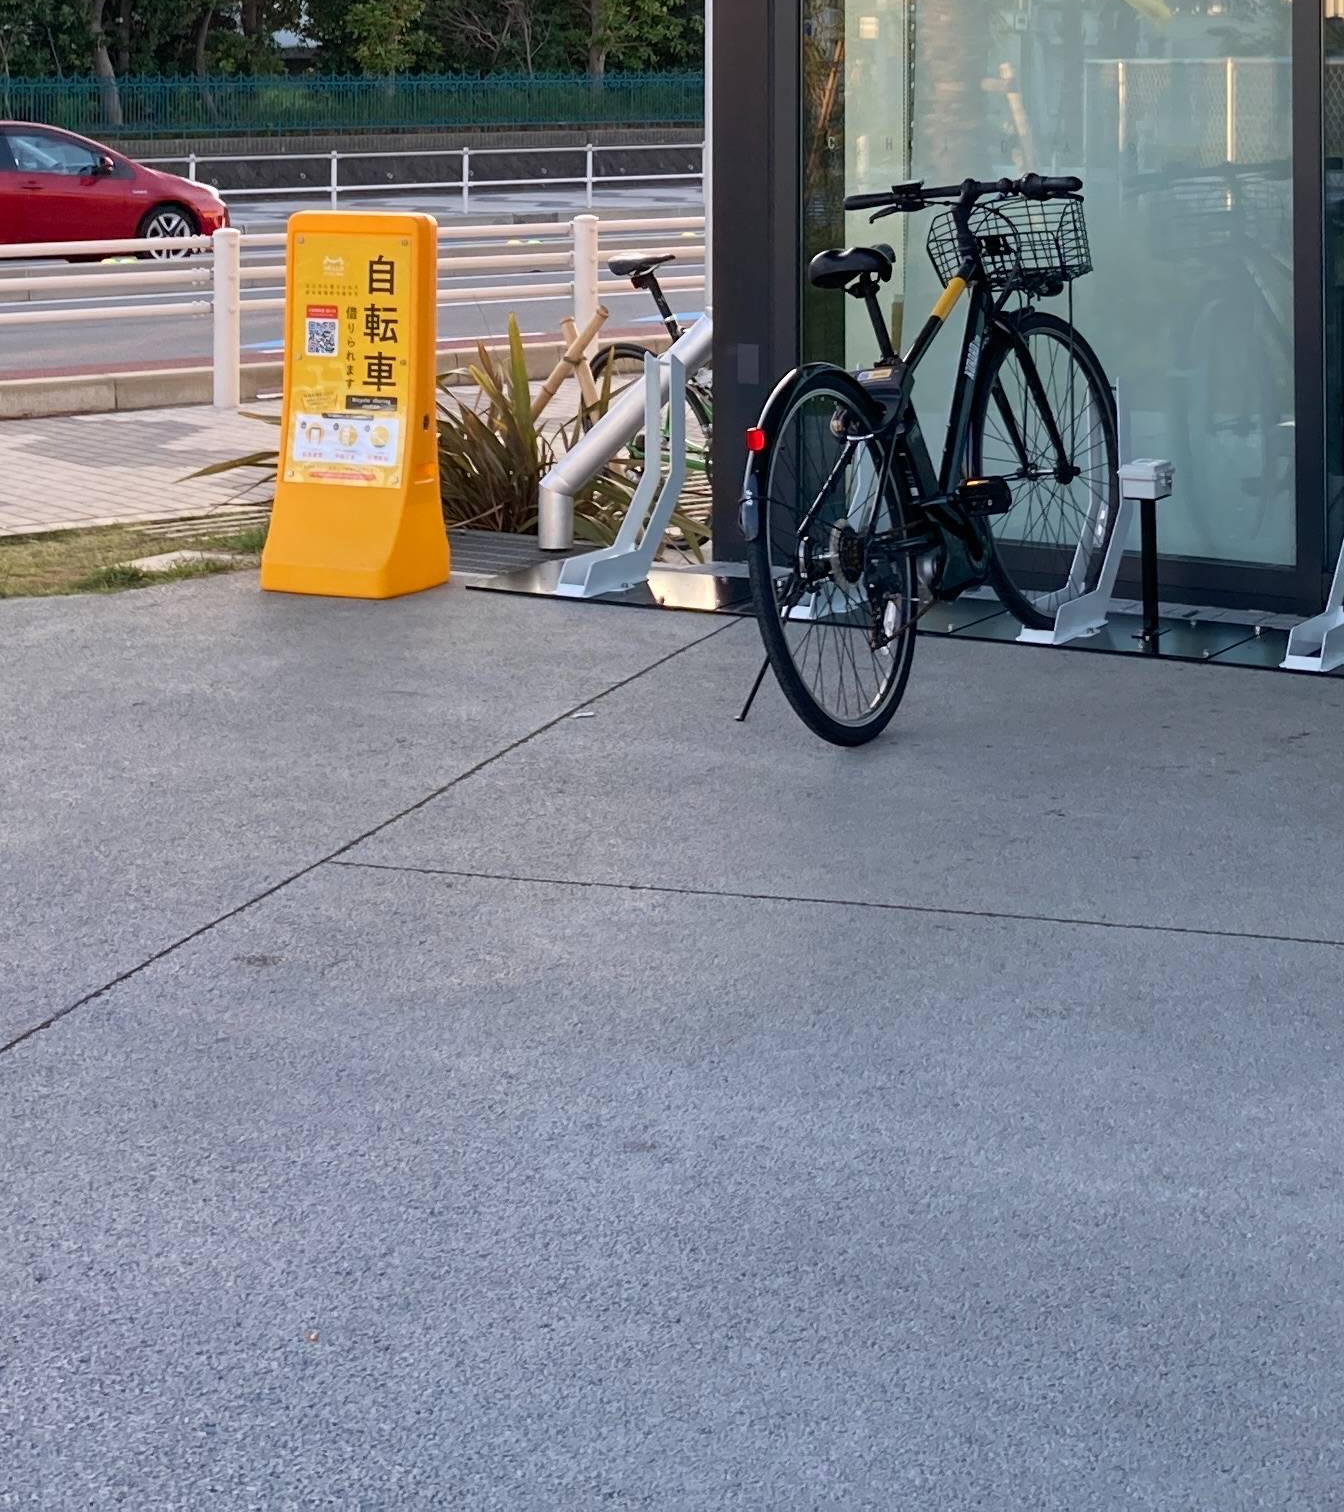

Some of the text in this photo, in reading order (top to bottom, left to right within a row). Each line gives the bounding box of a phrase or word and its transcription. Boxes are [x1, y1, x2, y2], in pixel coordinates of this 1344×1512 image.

[345, 306, 358, 389] 借りられます
[362, 254, 399, 392] 自転車
